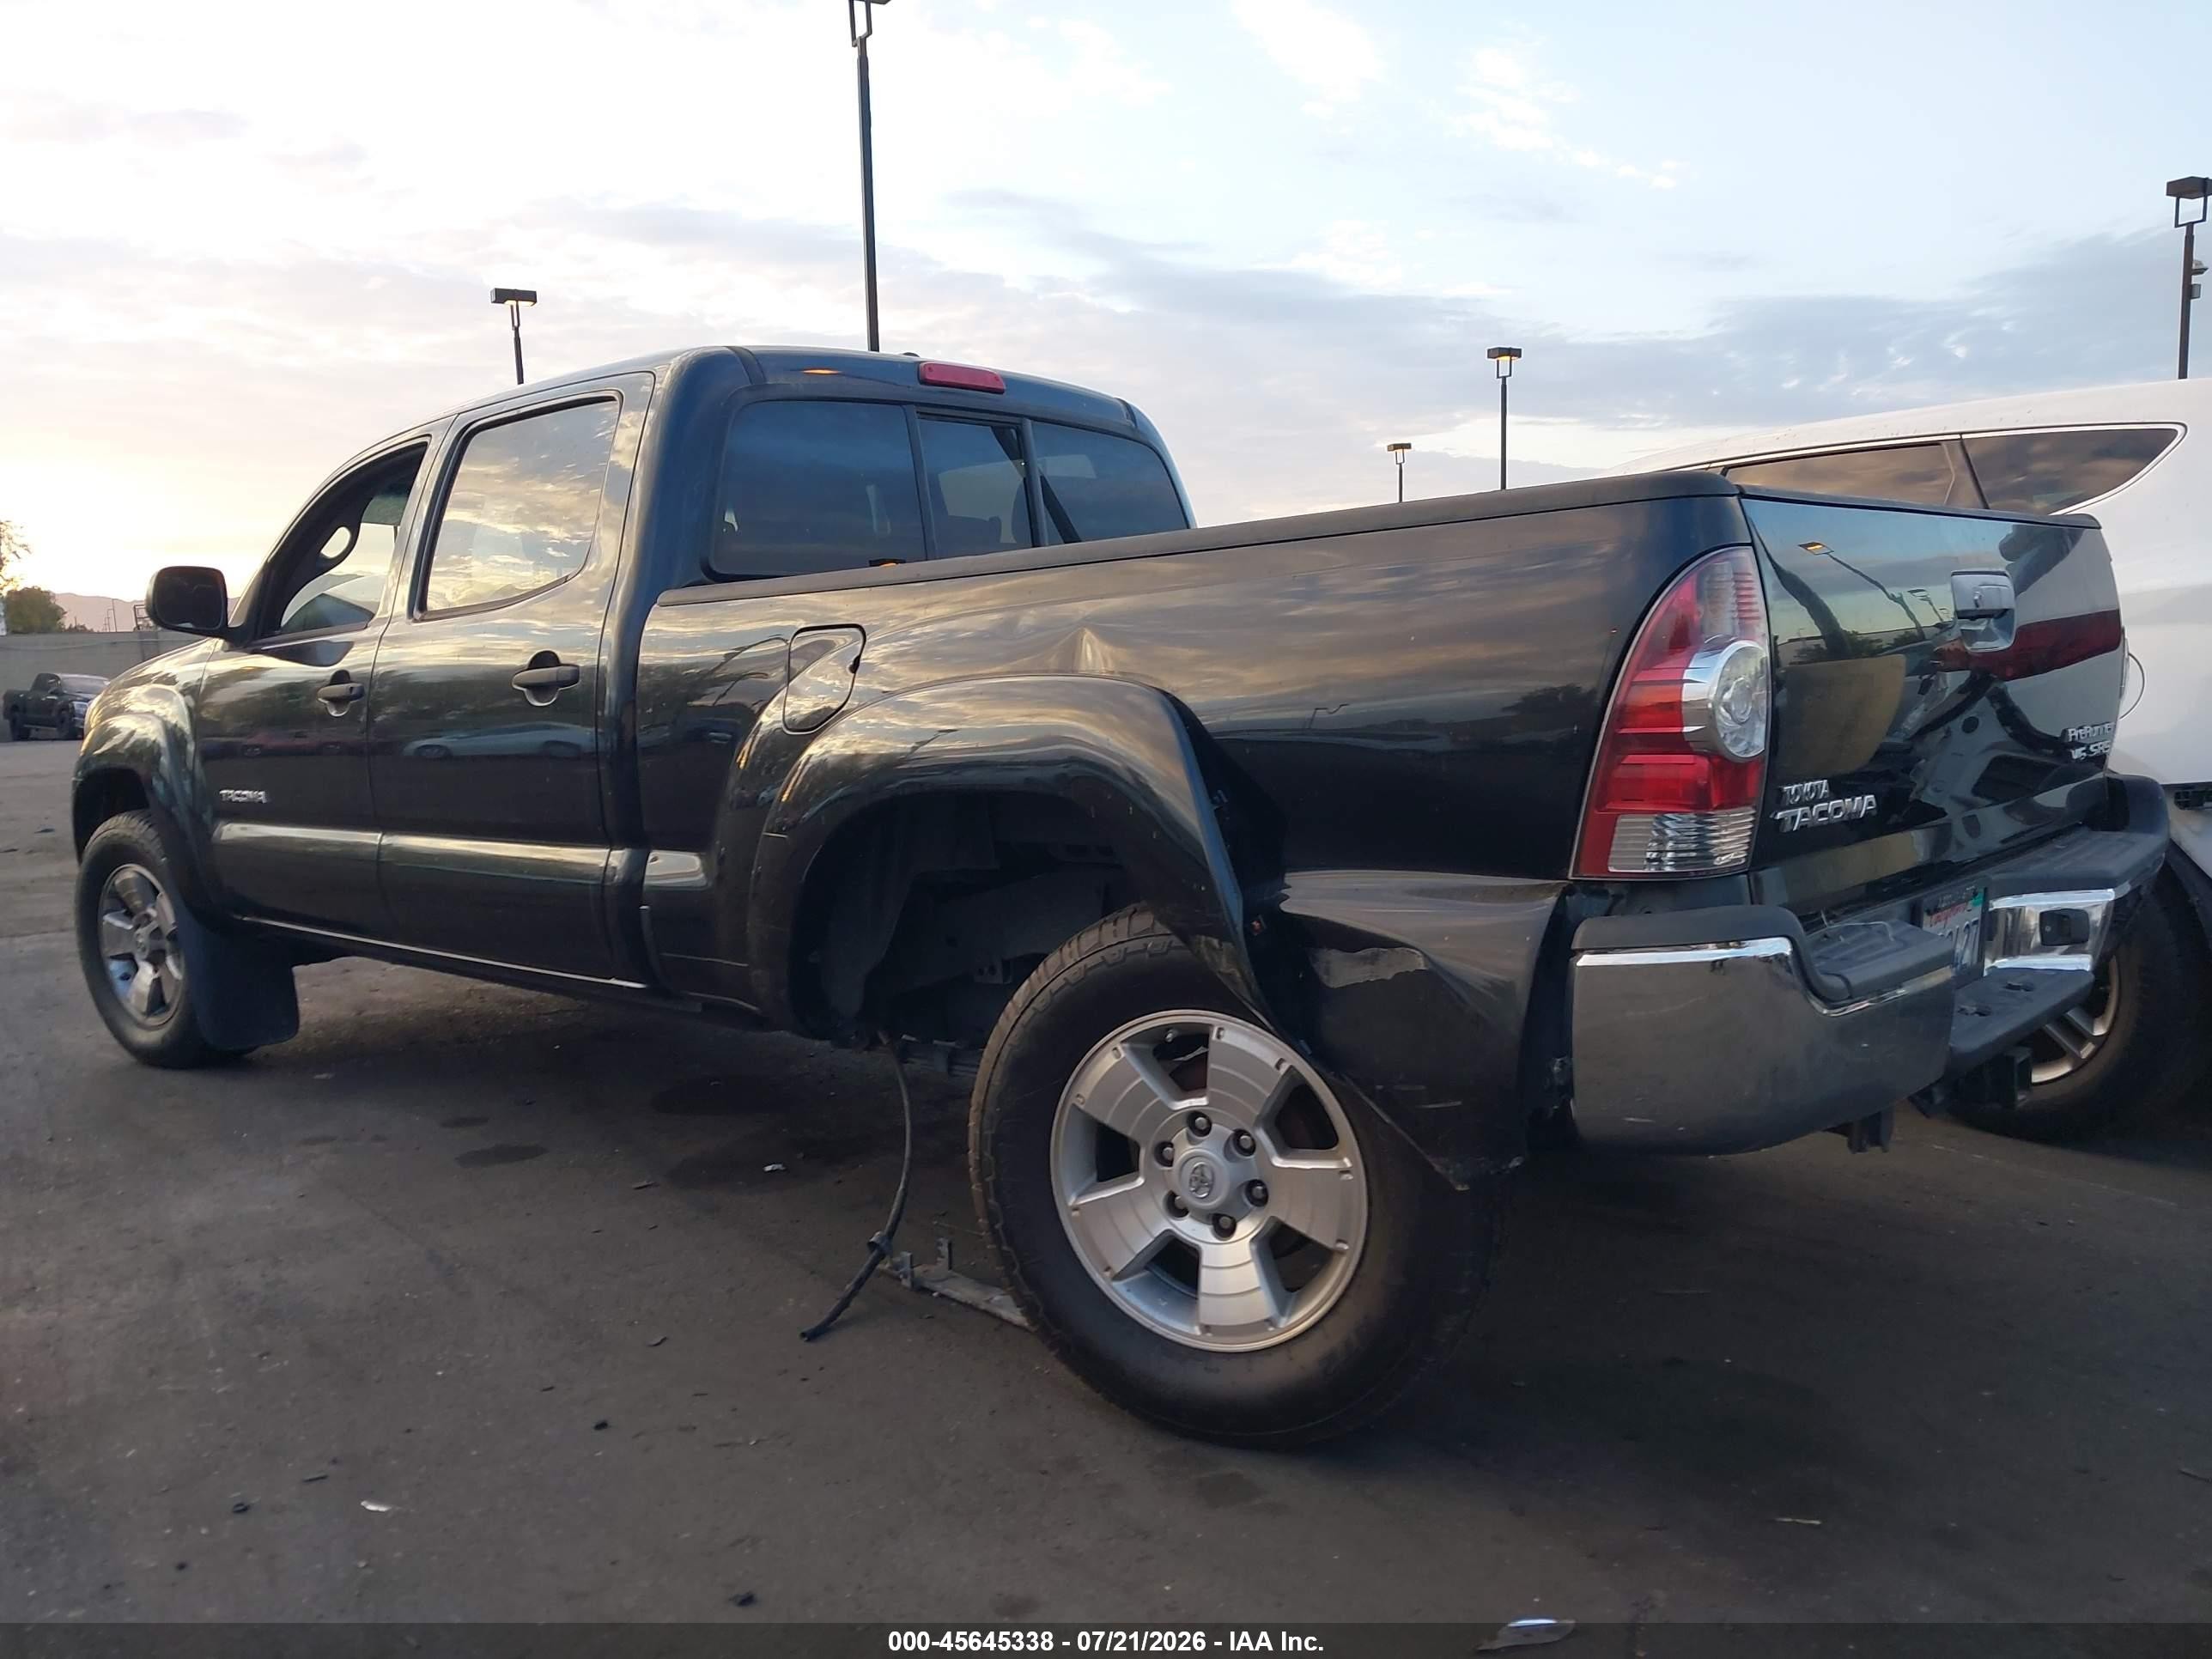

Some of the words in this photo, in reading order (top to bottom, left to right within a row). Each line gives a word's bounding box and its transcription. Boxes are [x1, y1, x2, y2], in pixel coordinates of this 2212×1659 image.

[219, 789, 267, 804] TACOMA
[1782, 779, 1829, 805] TOYOTA
[1774, 794, 1877, 832] TACOMA
